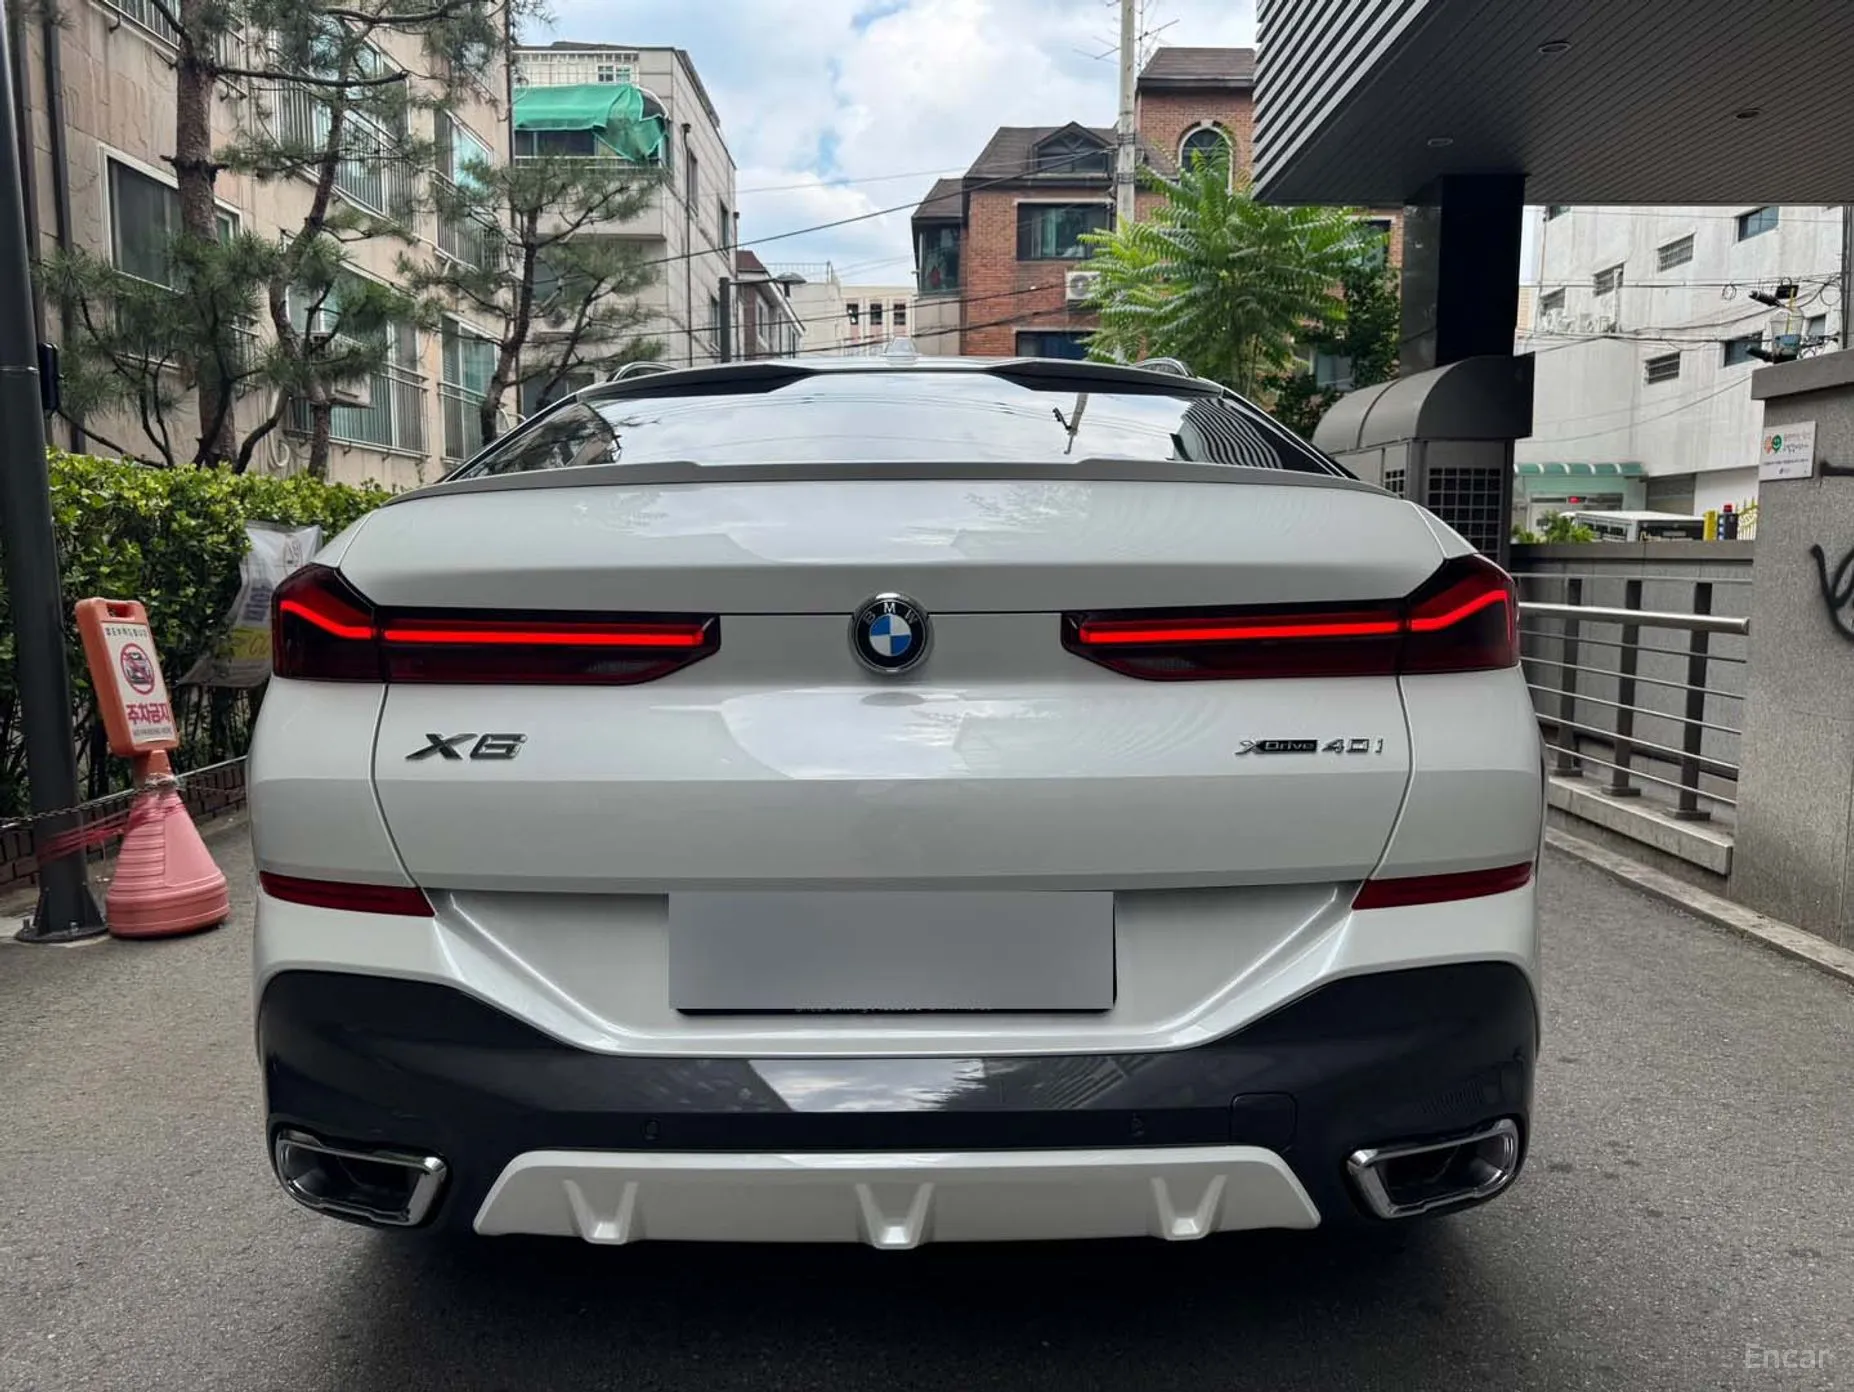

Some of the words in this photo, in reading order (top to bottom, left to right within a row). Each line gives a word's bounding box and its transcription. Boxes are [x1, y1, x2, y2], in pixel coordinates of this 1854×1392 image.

[863, 601, 918, 625] BMW
[126, 702, 171, 725] 주차금지
[405, 732, 528, 761] X6
